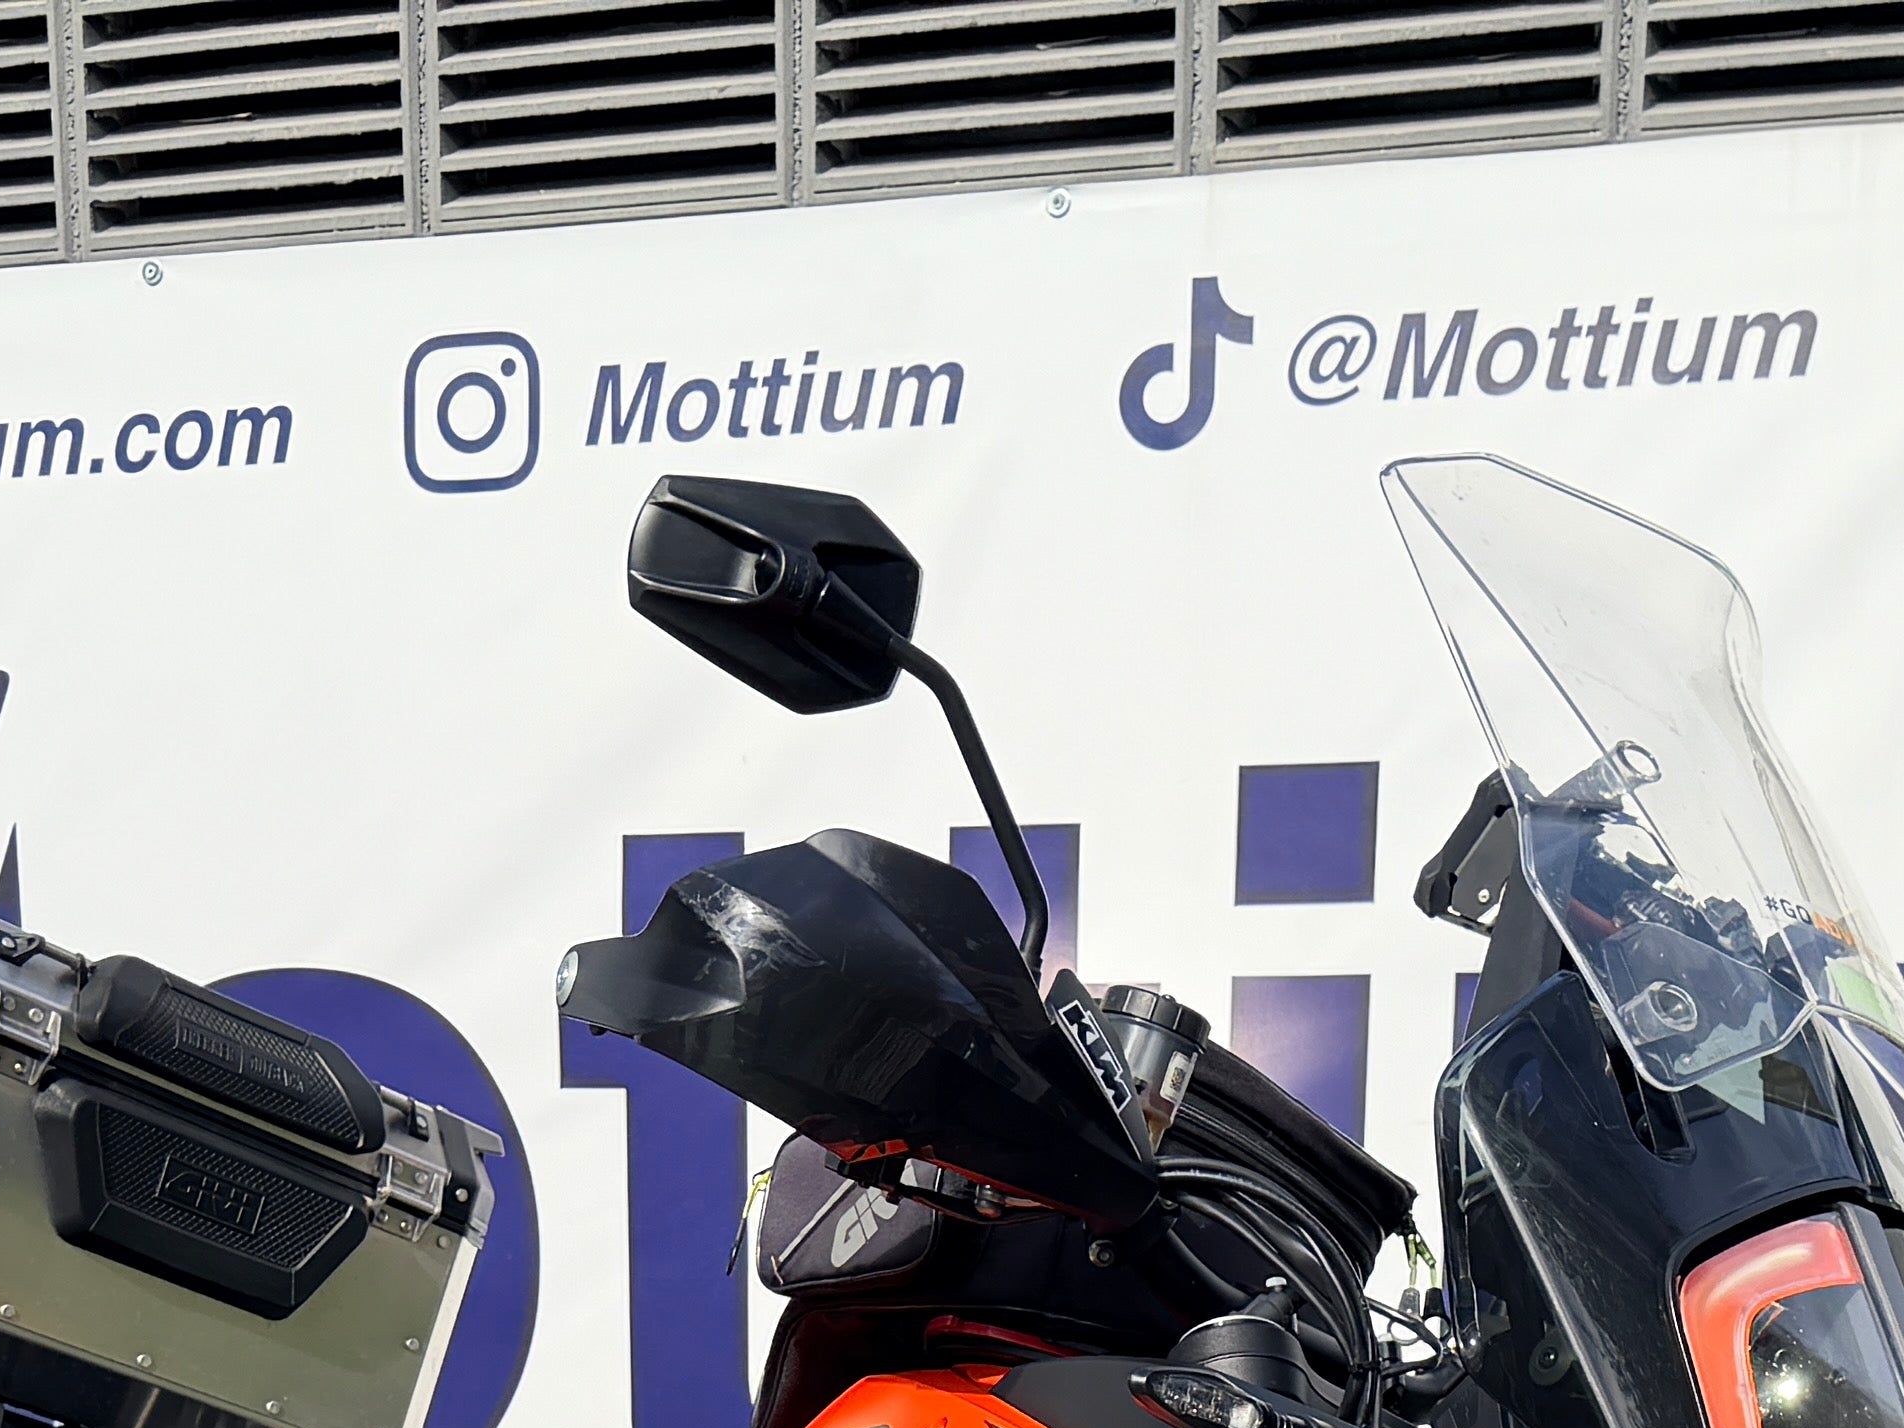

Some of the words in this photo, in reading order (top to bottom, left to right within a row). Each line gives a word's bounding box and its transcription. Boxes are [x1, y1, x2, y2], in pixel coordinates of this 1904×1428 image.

[586, 351, 964, 446] Mottium
[1288, 298, 1817, 406] @Mottium
[1058, 1000, 1132, 1115] KTM
